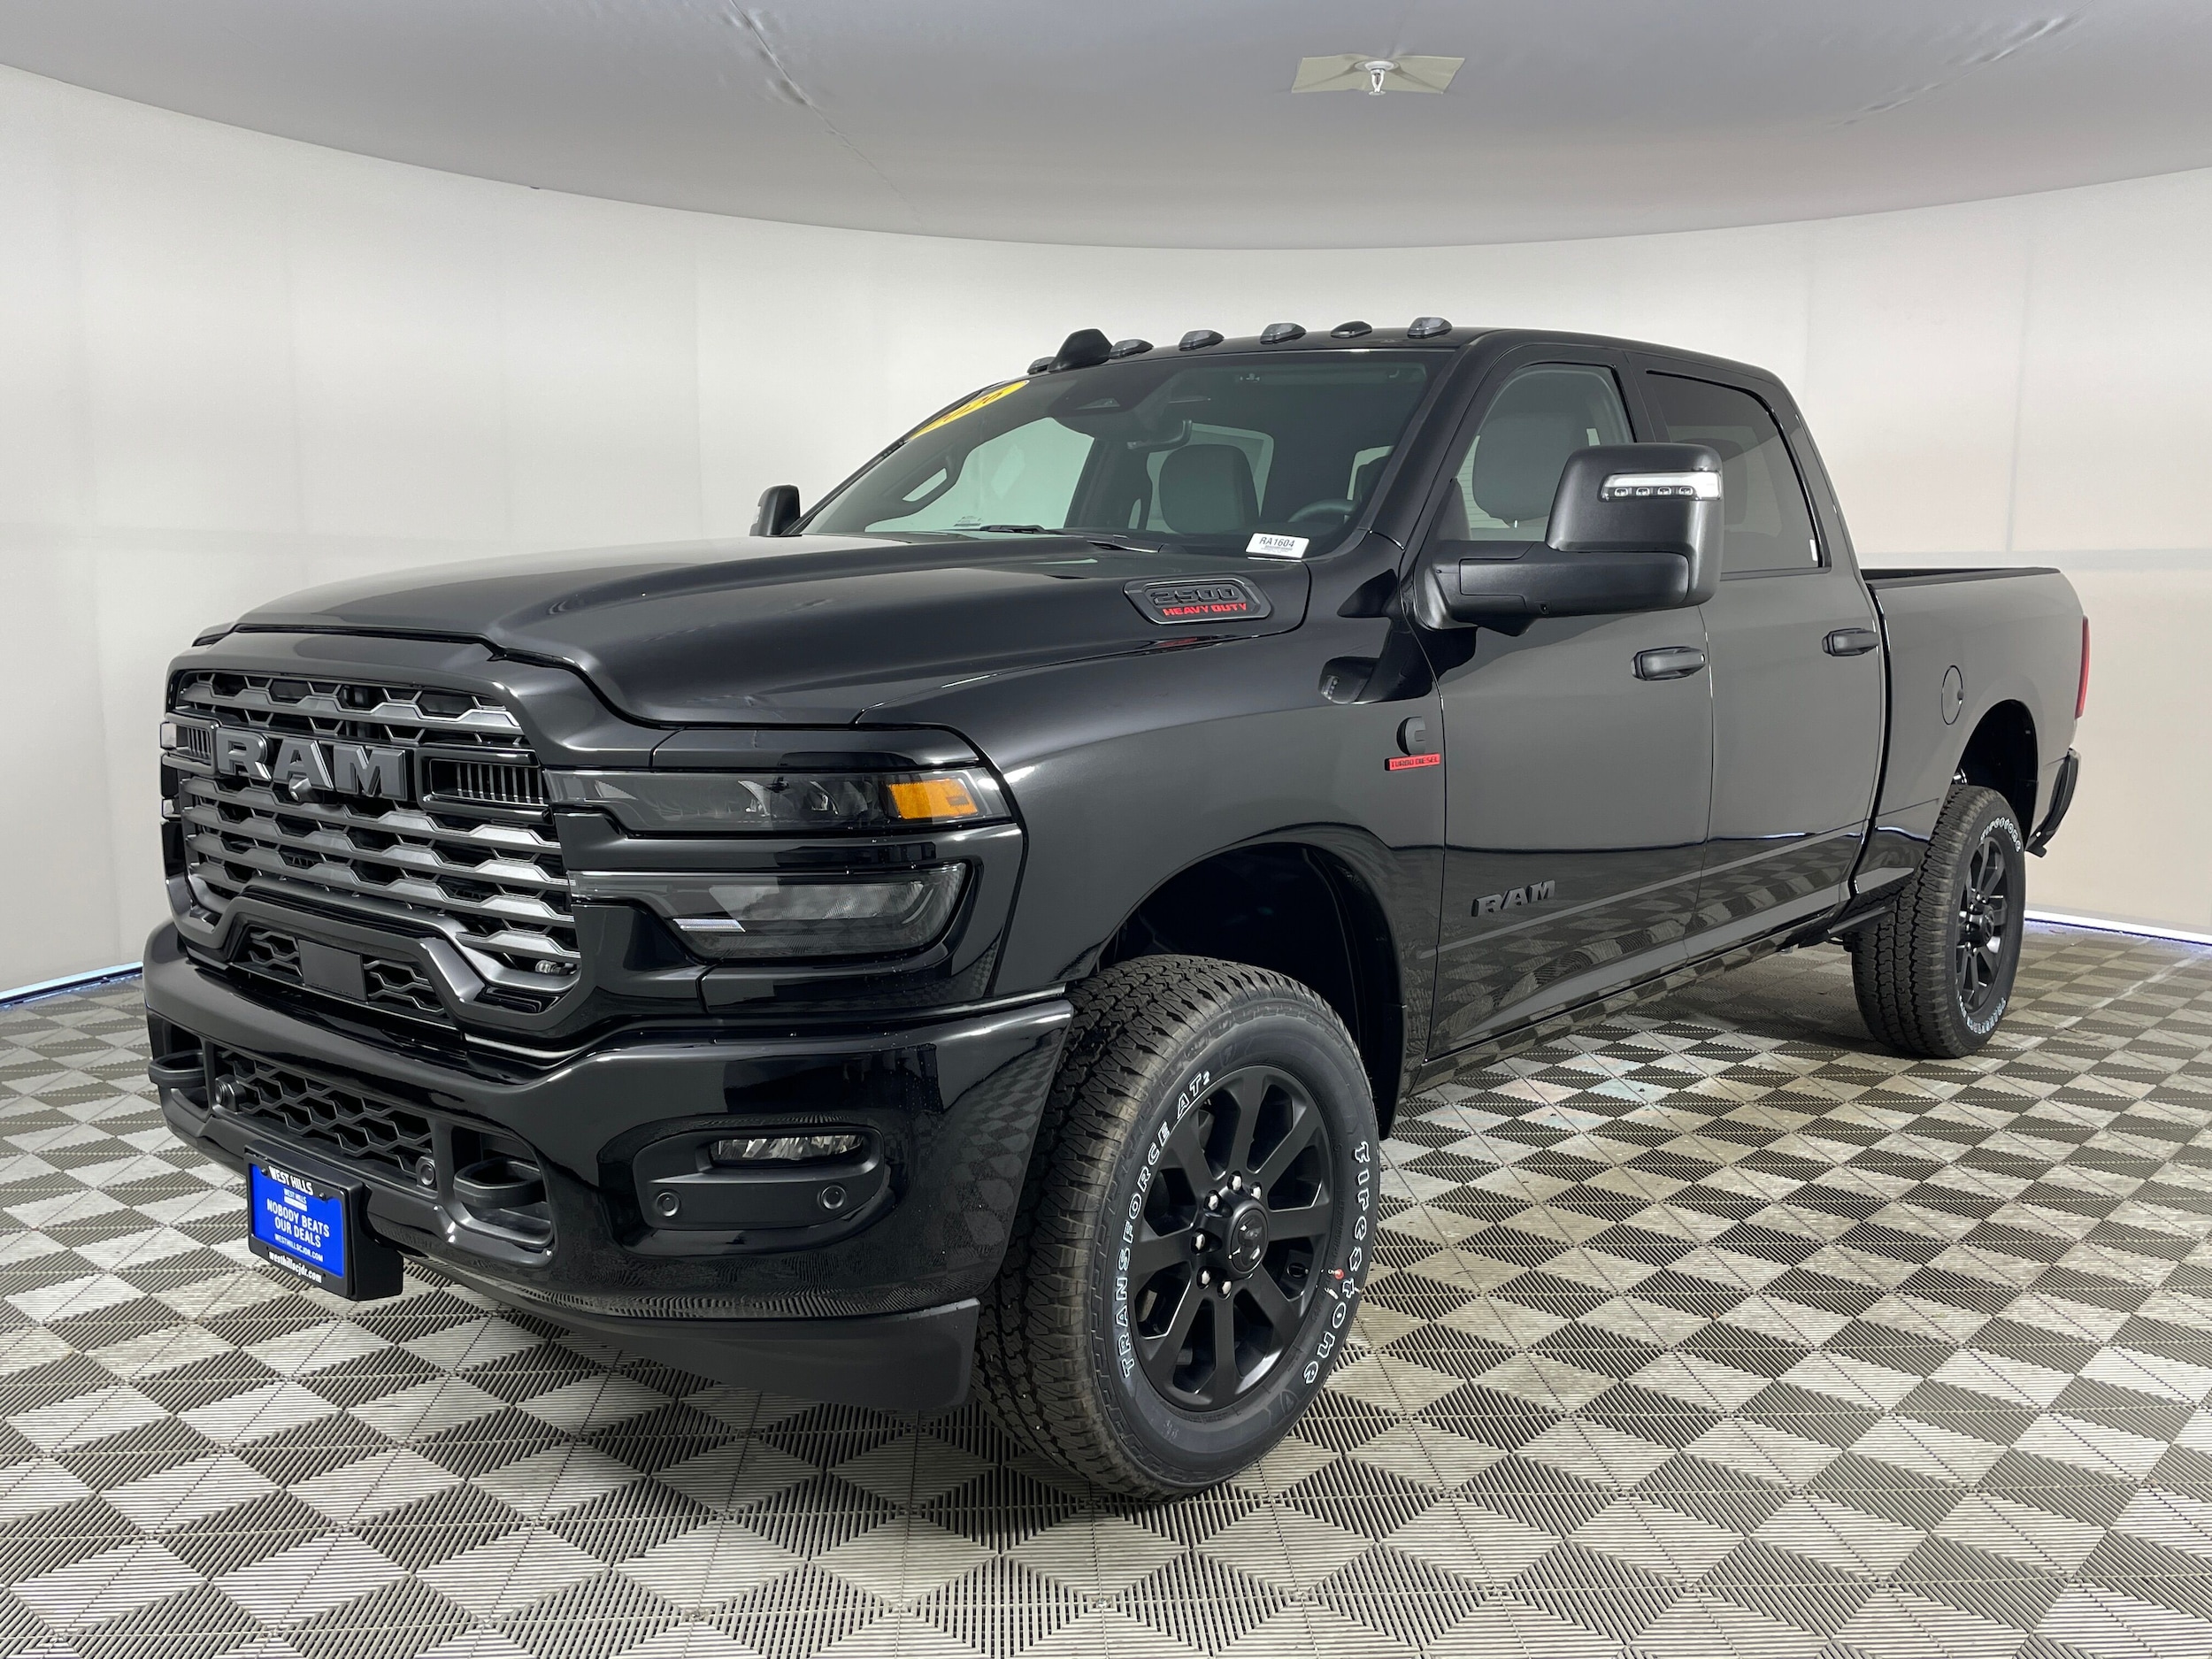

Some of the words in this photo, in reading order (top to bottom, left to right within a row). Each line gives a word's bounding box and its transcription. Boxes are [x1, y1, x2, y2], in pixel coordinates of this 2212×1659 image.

[1259, 536, 1295, 548] RA1604
[1150, 587, 1240, 606] 2500
[1162, 604, 1210, 618] HEAVY
[1211, 603, 1248, 613] DUTY
[216, 729, 407, 797] RAM
[1390, 758, 1415, 768] TURBO
[1415, 756, 1438, 765] DIESEL
[1471, 879, 1555, 917] RAM
[268, 1165, 293, 1186] WEST
[290, 1175, 314, 1196] HILLS
[266, 1198, 299, 1224] NOBODY
[301, 1214, 330, 1238] BEATS
[274, 1217, 293, 1235] OUR
[293, 1225, 322, 1248] DEALS
[274, 1233, 324, 1263] WESTHILLSCJDR.COM
[1114, 1121, 1171, 1379] TRANSFORCE
[1303, 1141, 1370, 1385] Firestone
[268, 1251, 323, 1284] westhillscjdr.com
